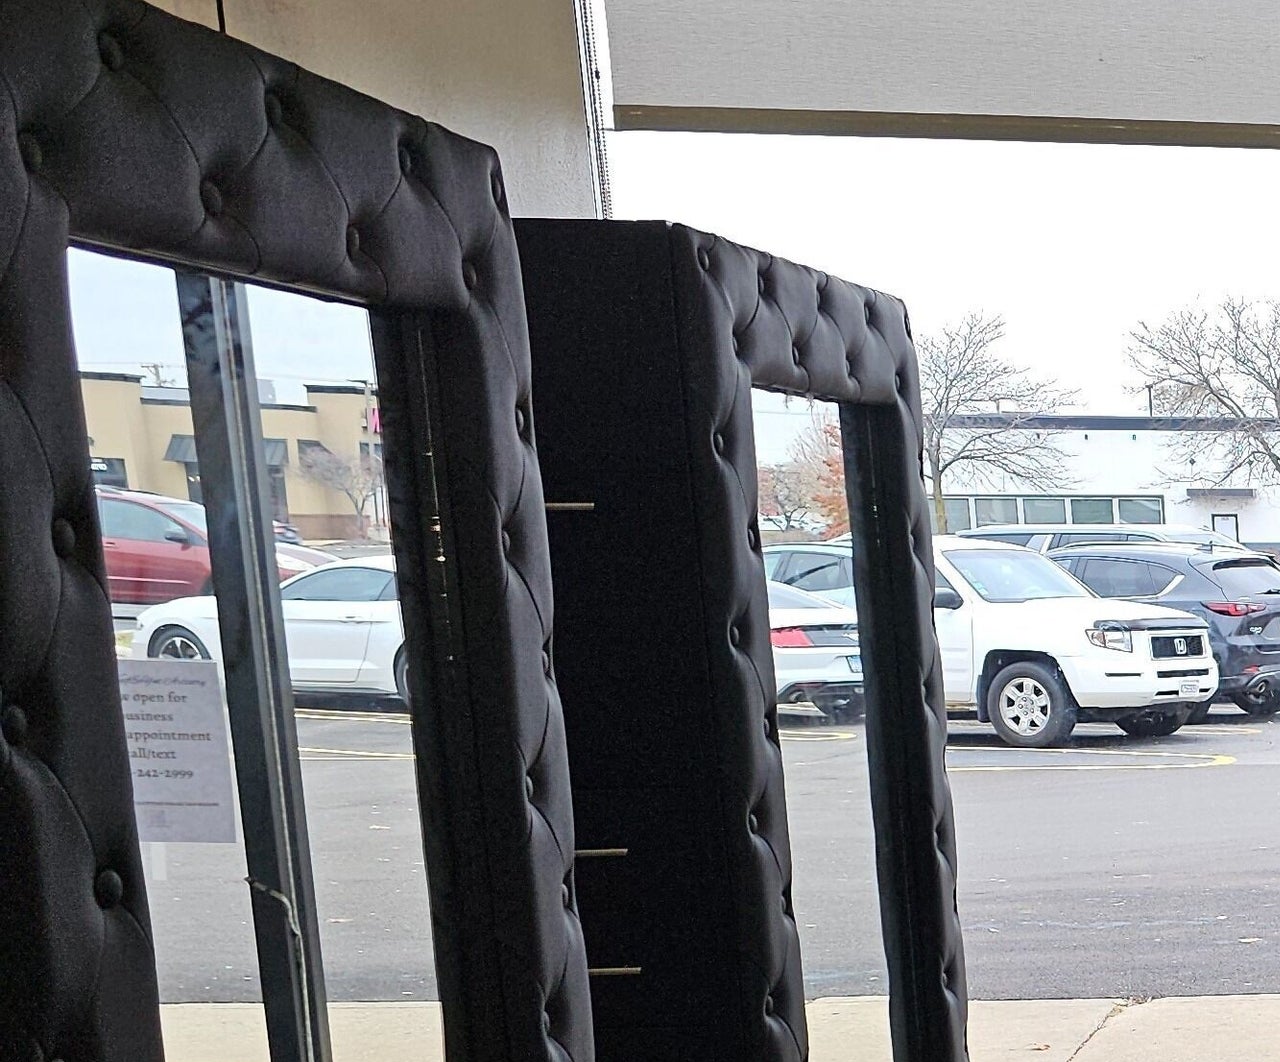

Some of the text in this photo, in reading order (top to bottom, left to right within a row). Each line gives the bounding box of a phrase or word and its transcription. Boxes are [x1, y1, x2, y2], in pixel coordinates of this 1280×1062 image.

[168, 691, 188, 703] for
[125, 711, 174, 722] usiness
[131, 747, 177, 760] all/text
[132, 769, 194, 779] -242-2999
